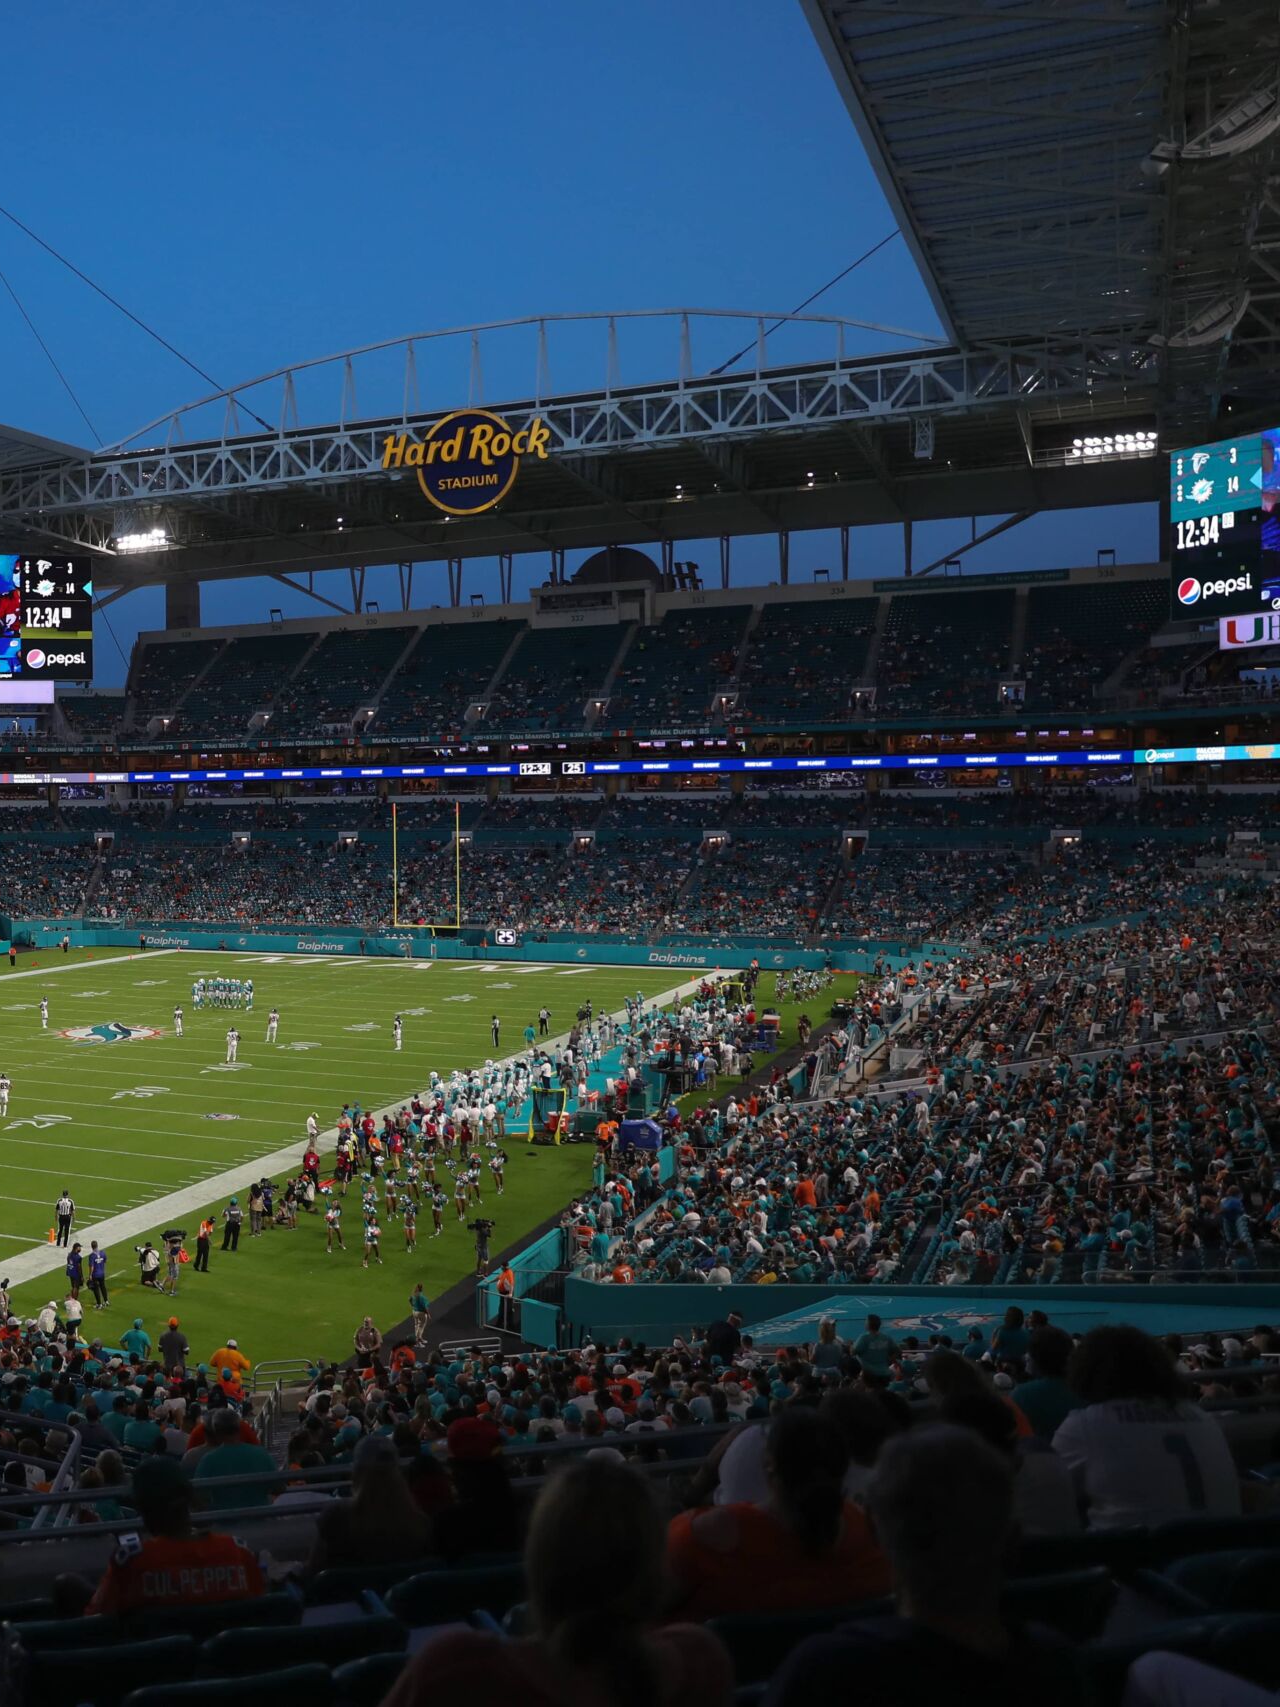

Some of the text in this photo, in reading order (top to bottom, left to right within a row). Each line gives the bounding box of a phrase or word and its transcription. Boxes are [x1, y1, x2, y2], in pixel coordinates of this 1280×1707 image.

[382, 417, 550, 468] Hard Rock
[1230, 448, 1237, 464] 3
[438, 474, 498, 490] STADIUM
[1227, 476, 1239, 493] 14
[1176, 516, 1220, 550] 12:34
[67, 562, 73, 574] 3
[66, 583, 75, 595] 14
[1202, 573, 1252, 600] pepsi
[26, 607, 60, 628] 12:34
[46, 651, 86, 667] pepsi
[568, 763, 581, 774] 25
[146, 936, 189, 947] Dolphins
[498, 931, 514, 943] 25
[297, 941, 344, 952] Dolphins
[234, 957, 597, 975] MIAMI
[649, 952, 706, 964] Dolphins
[10, 1114, 72, 1128] 20
[1162, 1434, 1206, 1511] 1
[143, 1564, 249, 1598] CULPEPPER
